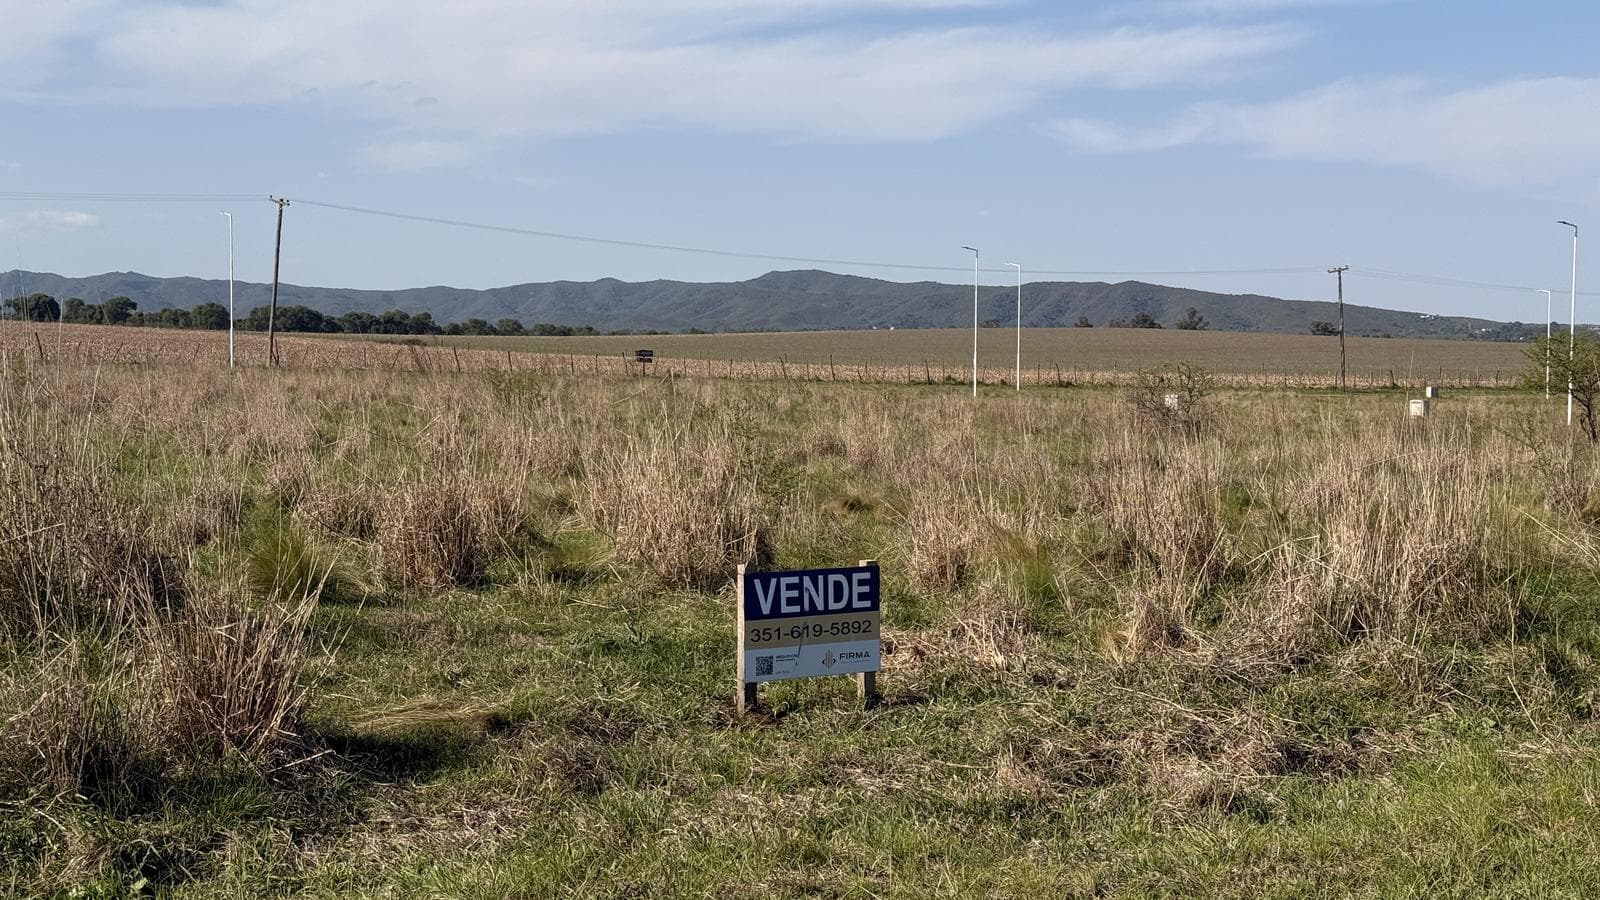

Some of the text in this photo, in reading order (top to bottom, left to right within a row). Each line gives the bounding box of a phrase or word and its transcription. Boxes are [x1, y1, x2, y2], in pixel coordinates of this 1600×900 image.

[753, 572, 872, 615] VENDE
[750, 619, 872, 642] 351-619-5892
[839, 651, 871, 660] FIRMA
